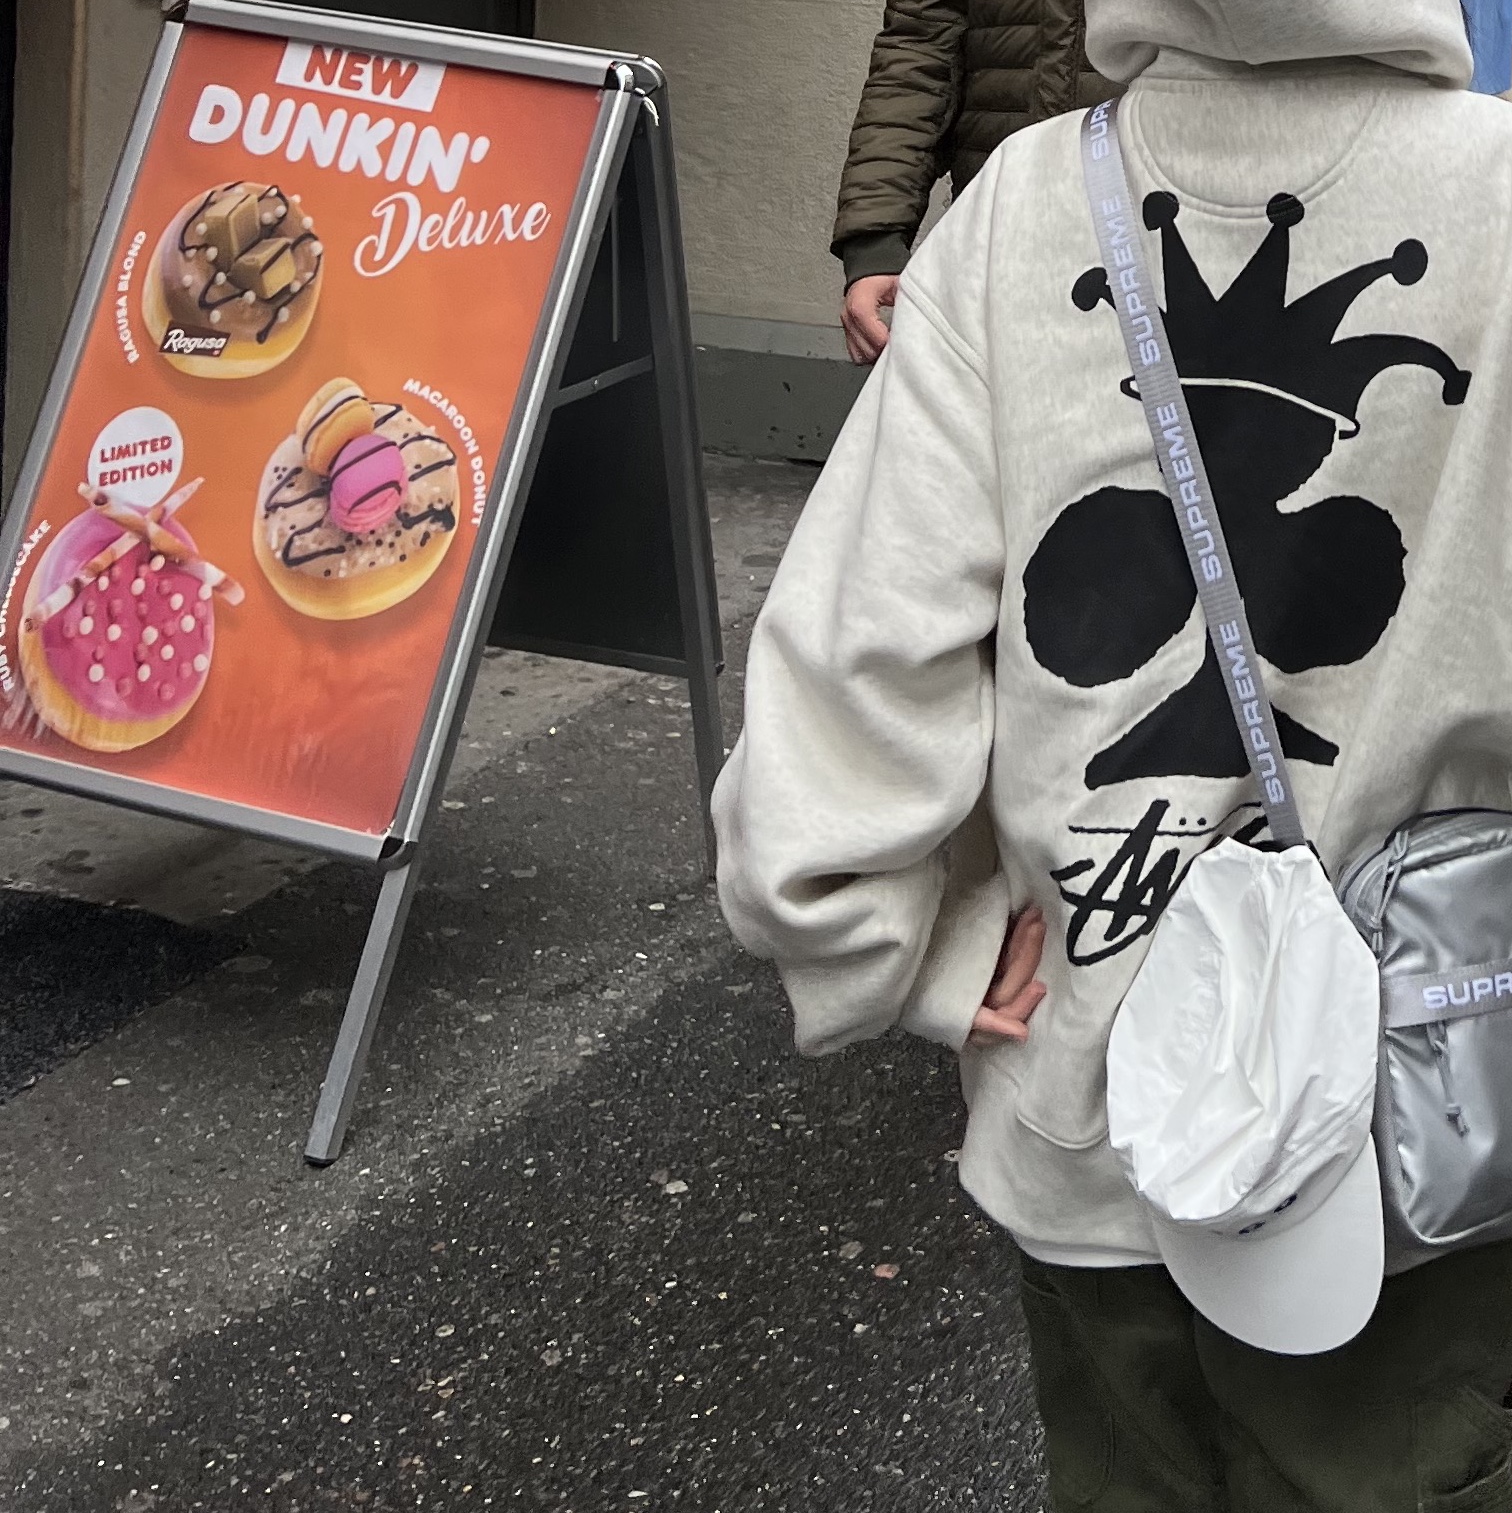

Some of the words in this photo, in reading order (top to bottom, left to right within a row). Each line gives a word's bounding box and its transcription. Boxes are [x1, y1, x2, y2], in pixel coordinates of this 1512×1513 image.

[304, 45, 419, 100] NEW
[189, 84, 491, 193] DUNKIN'
[354, 191, 552, 277] Deluxe
[1102, 195, 1162, 368] SUPREME
[164, 329, 227, 354] Ragusa
[100, 435, 172, 463] LIMITED
[403, 378, 480, 455] MACAROON
[99, 458, 173, 487] EDITION
[1157, 402, 1223, 583] SUPREME
[1219, 620, 1285, 805] SUPREME
